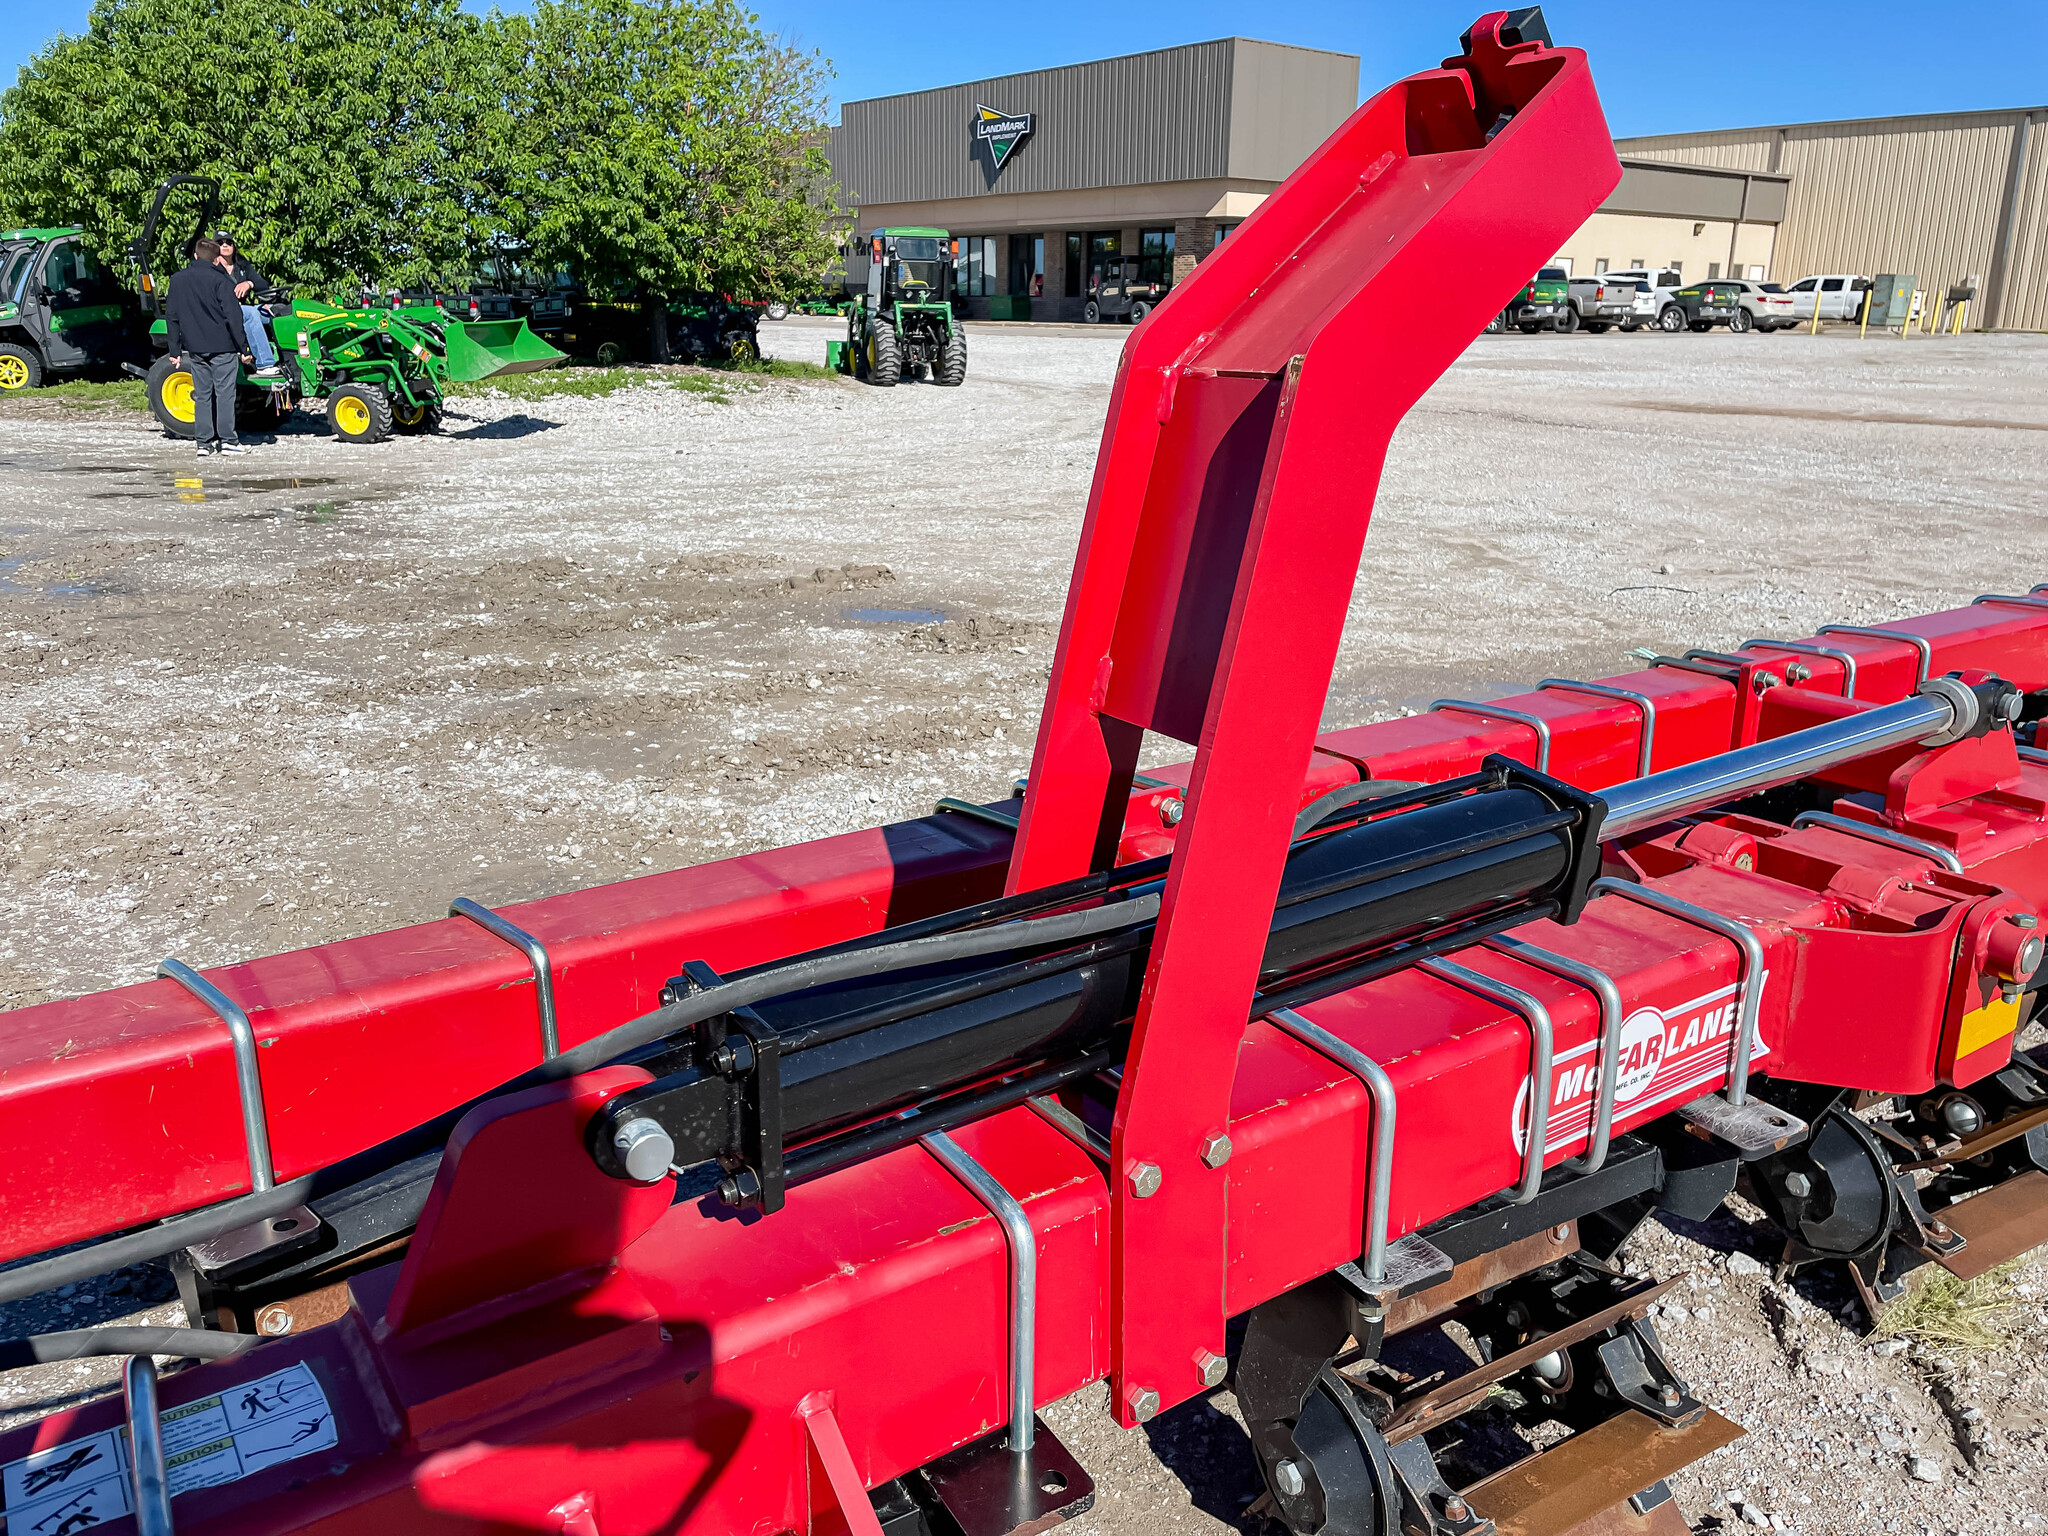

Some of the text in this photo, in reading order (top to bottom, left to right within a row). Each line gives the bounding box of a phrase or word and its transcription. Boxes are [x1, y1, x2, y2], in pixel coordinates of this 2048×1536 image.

[980, 121, 1026, 134] LANDMARK
[159, 1401, 213, 1422] AUTION
[168, 1441, 223, 1466] AUTION
